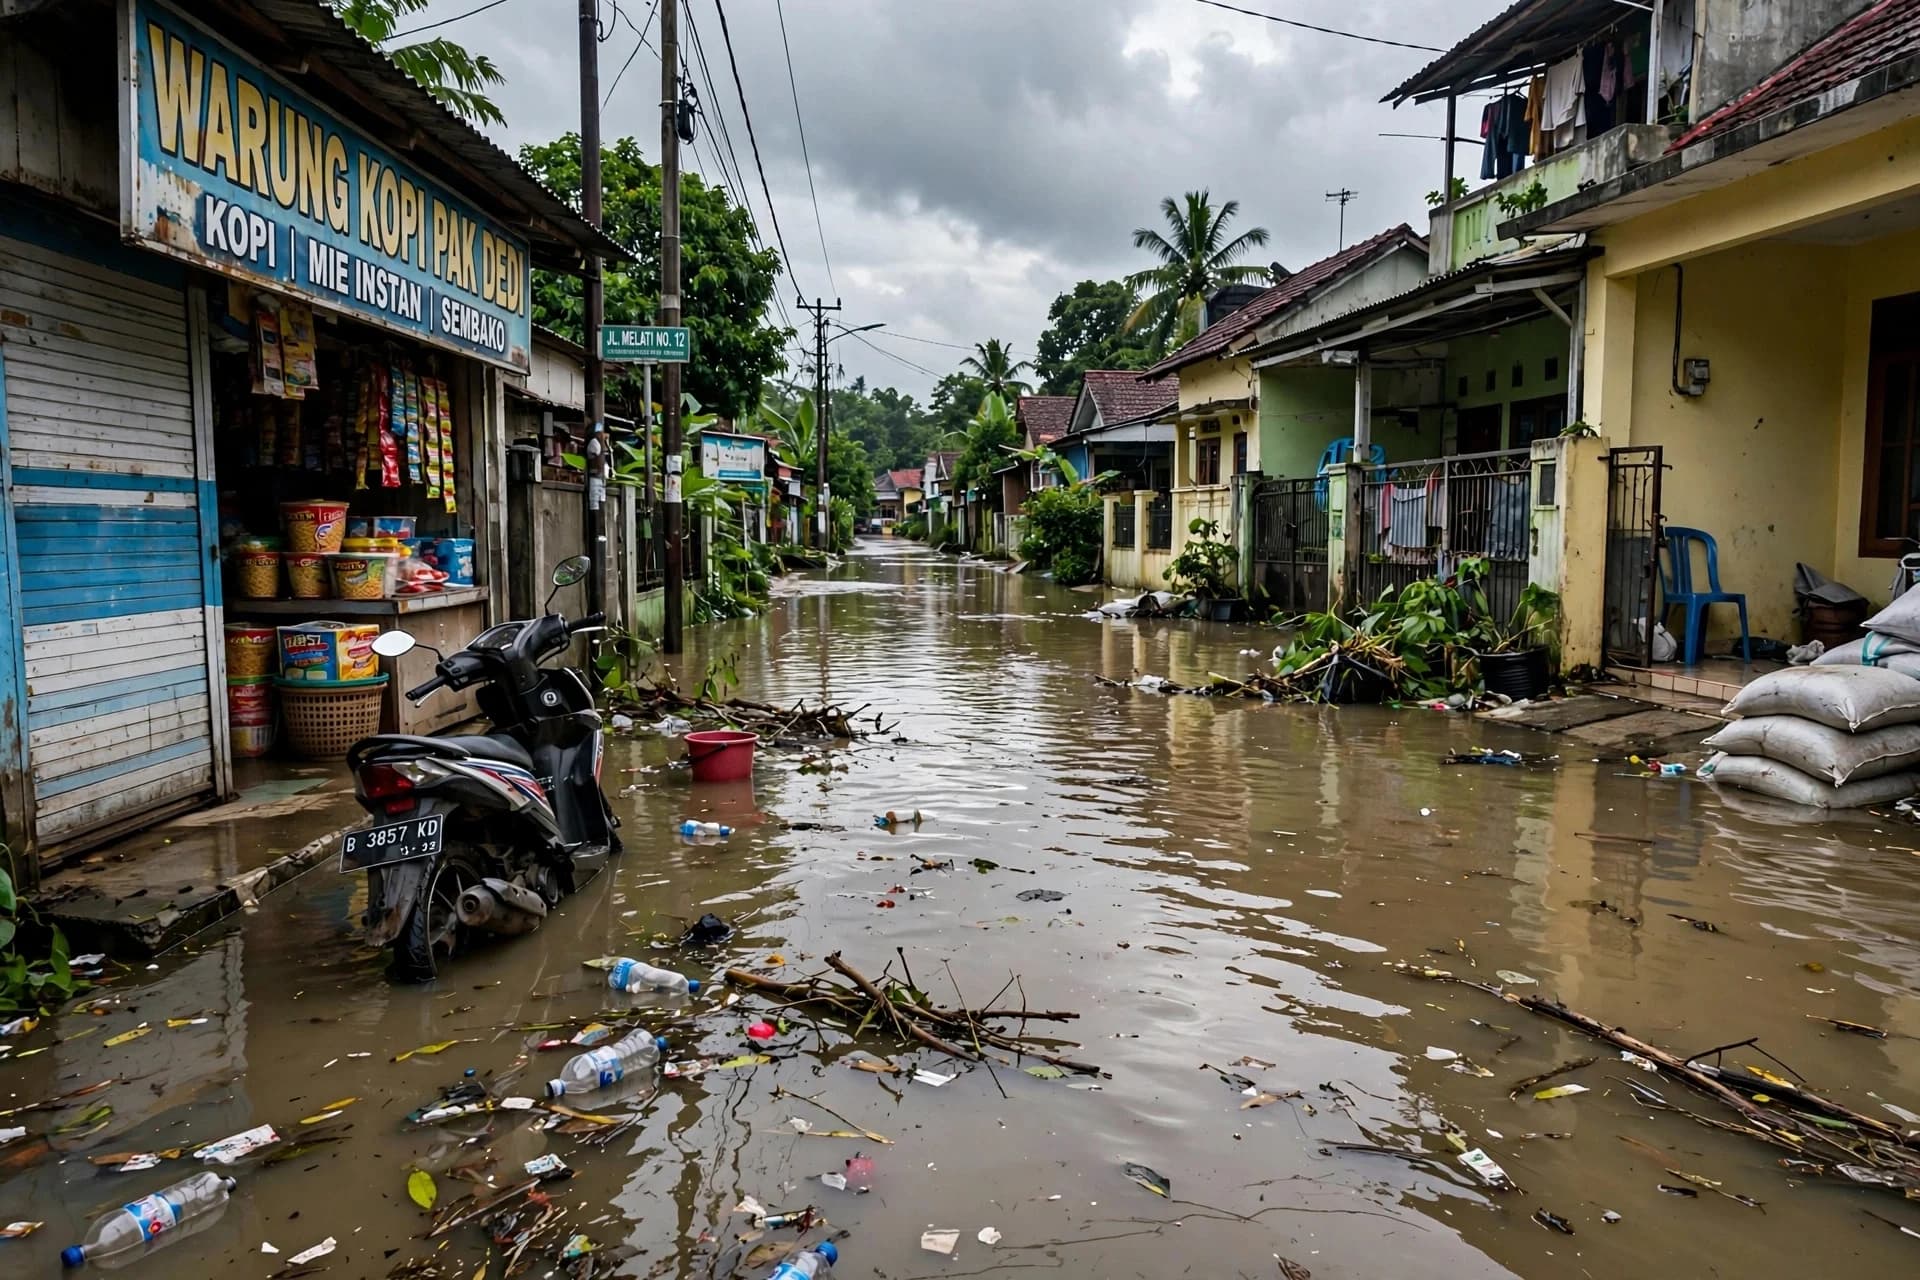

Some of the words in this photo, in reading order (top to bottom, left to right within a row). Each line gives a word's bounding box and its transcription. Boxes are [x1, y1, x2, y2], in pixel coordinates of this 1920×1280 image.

[148, 22, 350, 237] WARUNG
[359, 152, 426, 272] KOPI
[433, 196, 478, 296] PAK
[482, 226, 525, 317] DEDI
[205, 193, 277, 269] KOPI
[308, 238, 349, 296] MIE
[355, 258, 422, 323] INSTAN
[441, 296, 506, 353] SEMBAKO
[606, 330, 620, 346] JL.
[621, 331, 654, 346] MELATI
[656, 331, 672, 347] NO.
[674, 332, 685, 347] 12
[346, 837, 356, 853] B
[366, 825, 408, 848] 3857
[417, 820, 438, 838] KD
